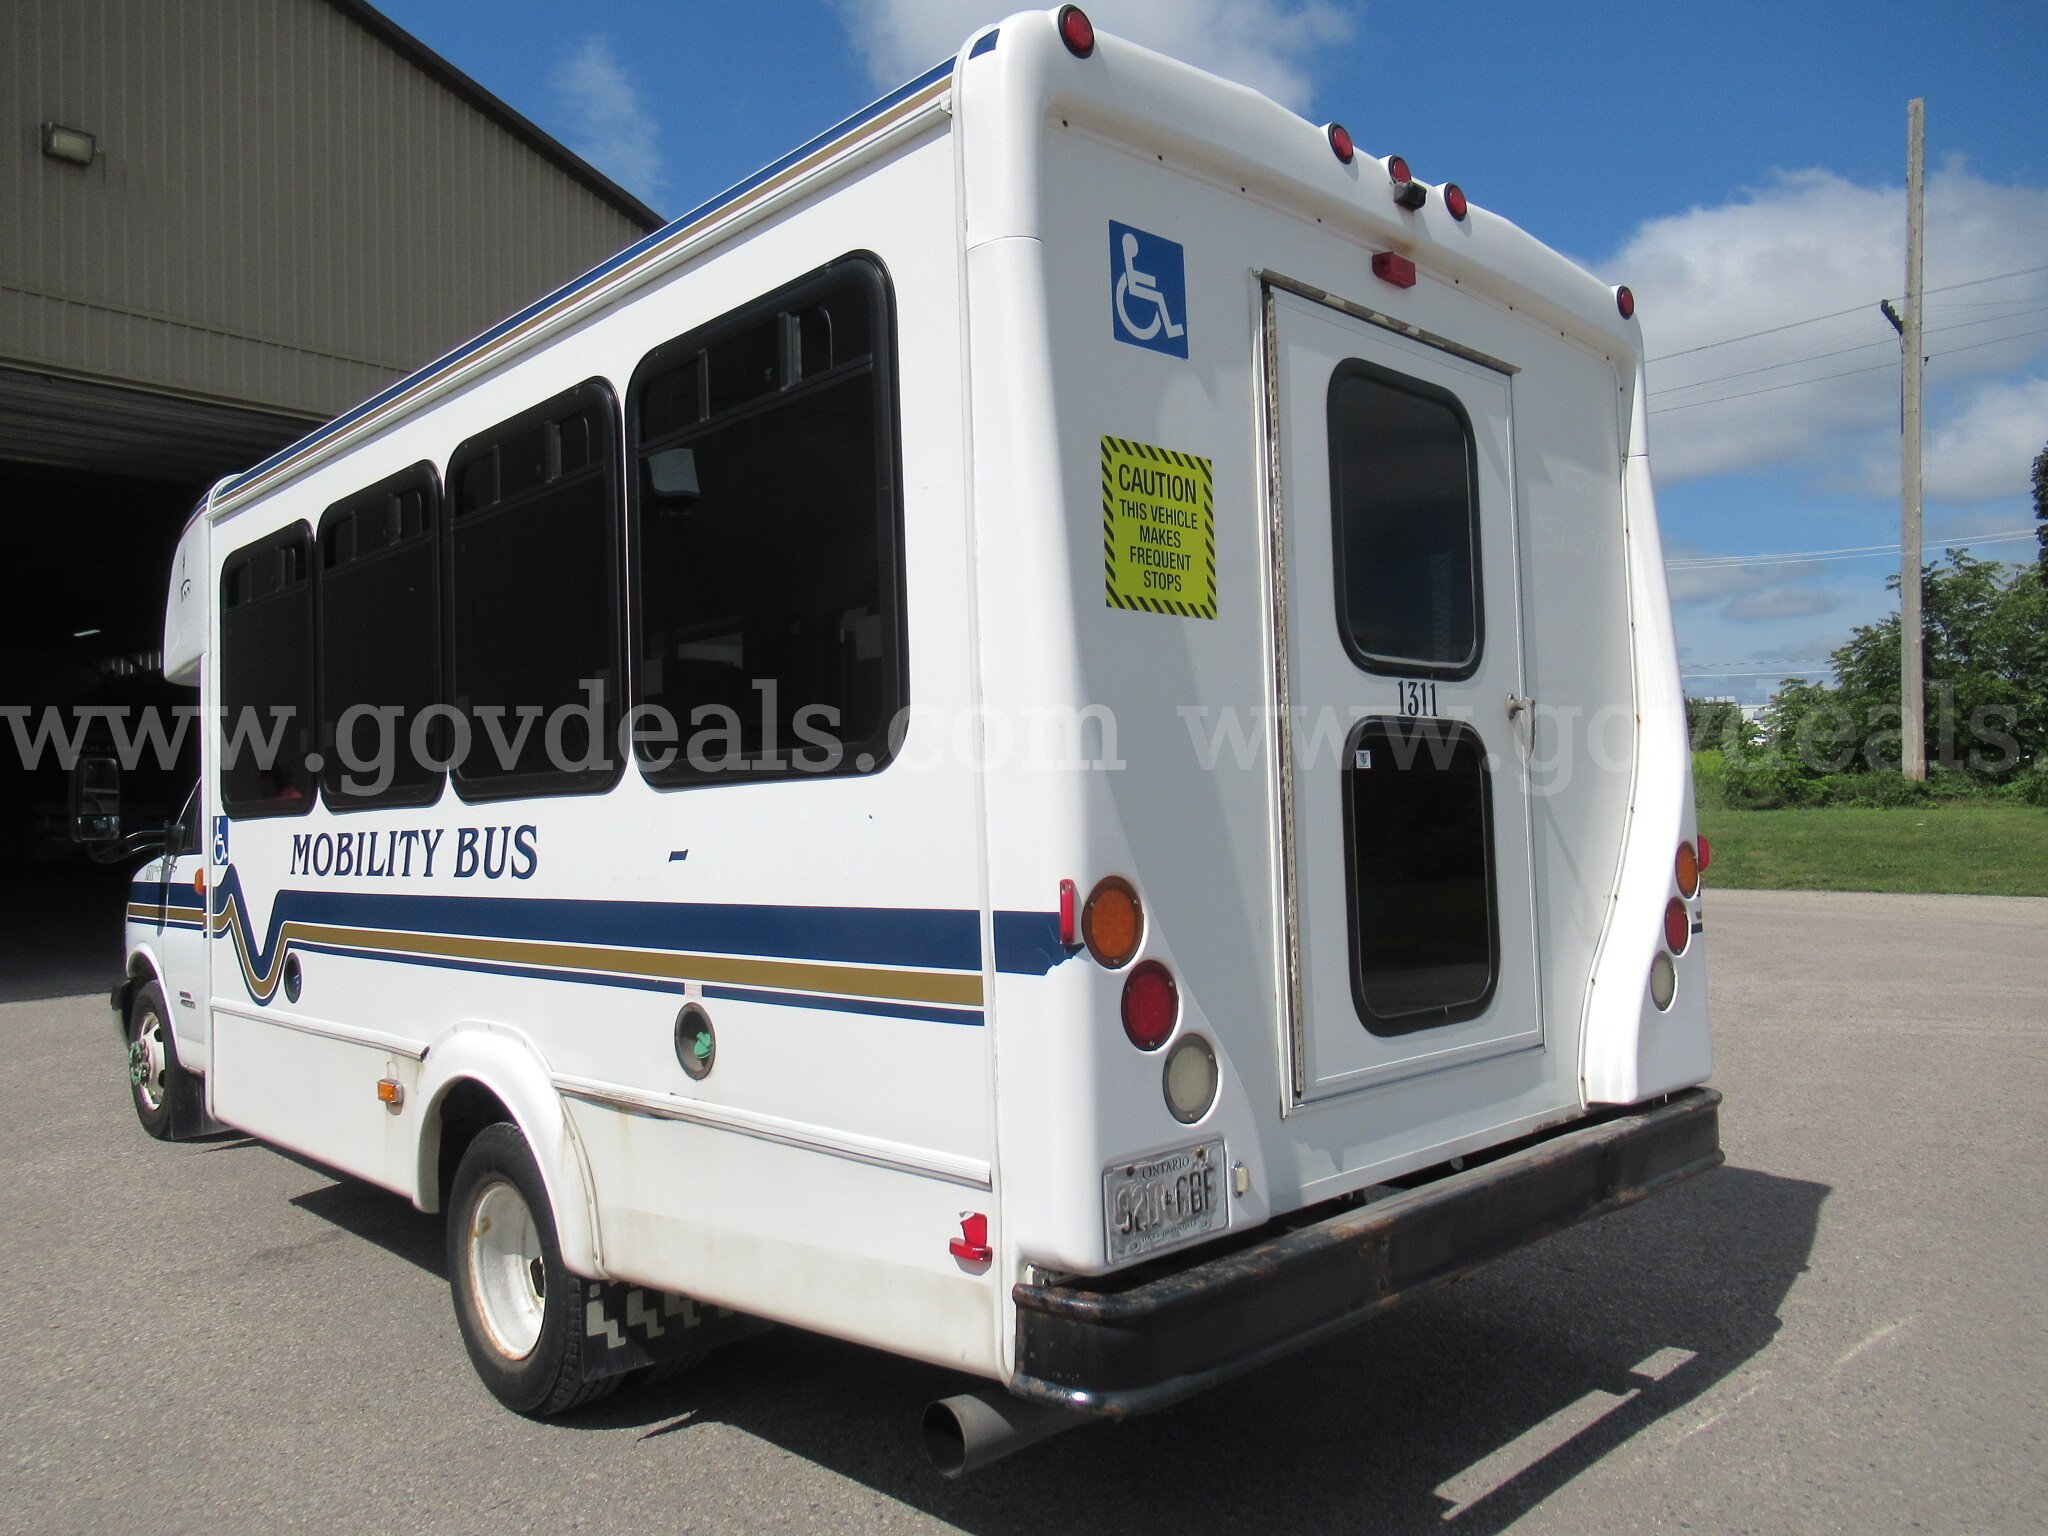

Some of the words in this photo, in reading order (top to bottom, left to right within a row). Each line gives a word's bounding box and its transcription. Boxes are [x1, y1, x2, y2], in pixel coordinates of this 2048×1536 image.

[1118, 463, 1197, 505] CAUTION
[1119, 499, 1147, 521] THIS
[1150, 505, 1198, 530] VEHICLE
[1139, 524, 1181, 548] MAKES
[1129, 545, 1191, 572] FREQUENT
[1143, 570, 1182, 592] STOPS
[1397, 679, 1438, 717] 1311
[290, 828, 445, 878] MOBILITY
[453, 824, 538, 880] BUS
[1142, 1156, 1190, 1179] ONTARIO
